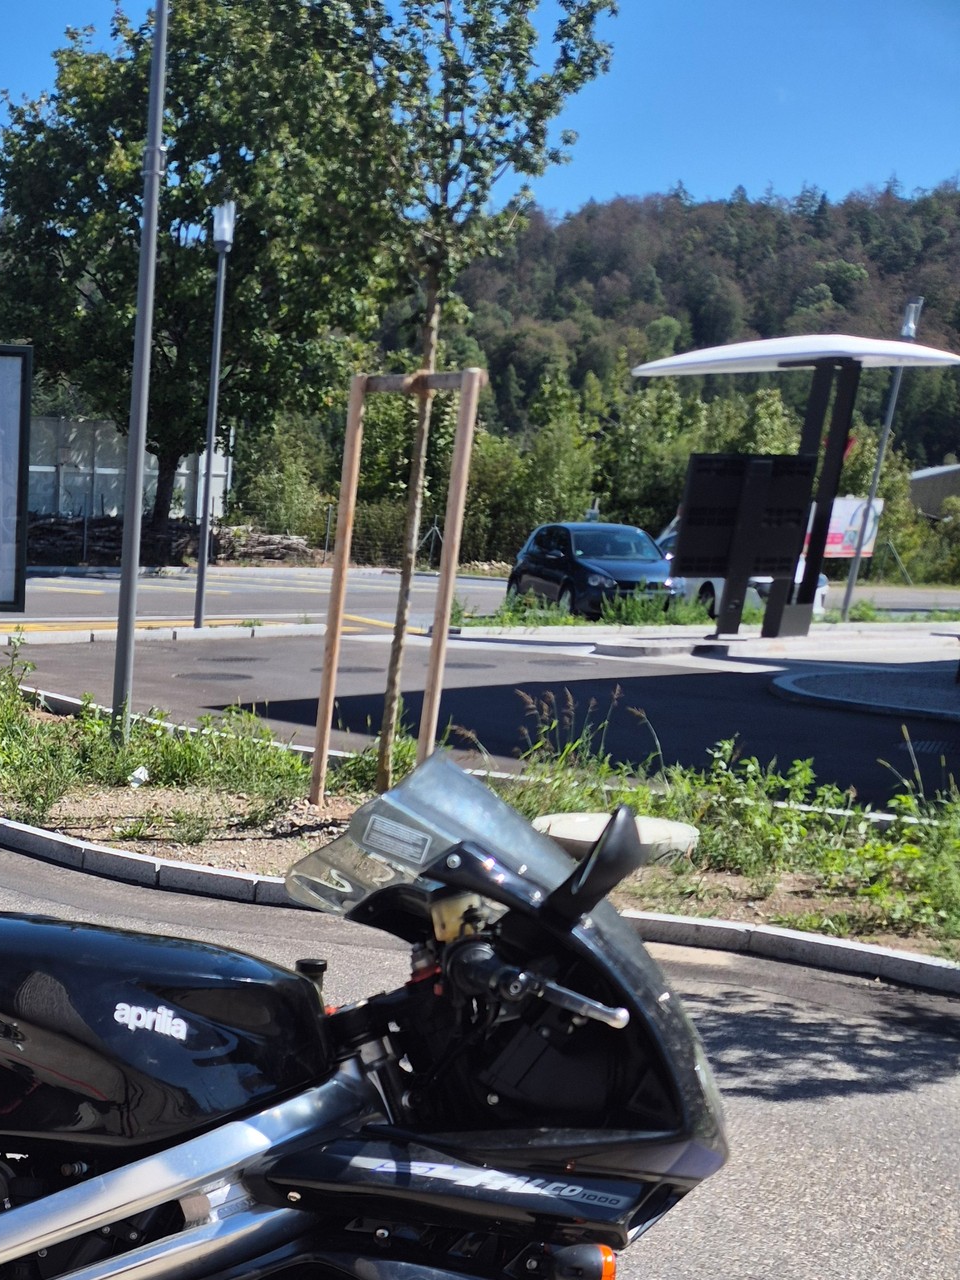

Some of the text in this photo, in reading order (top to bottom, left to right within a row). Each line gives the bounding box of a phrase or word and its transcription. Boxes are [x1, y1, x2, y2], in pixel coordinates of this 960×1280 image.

[113, 1002, 188, 1041] aprilia
[455, 1169, 621, 1207] FALCO 1000
